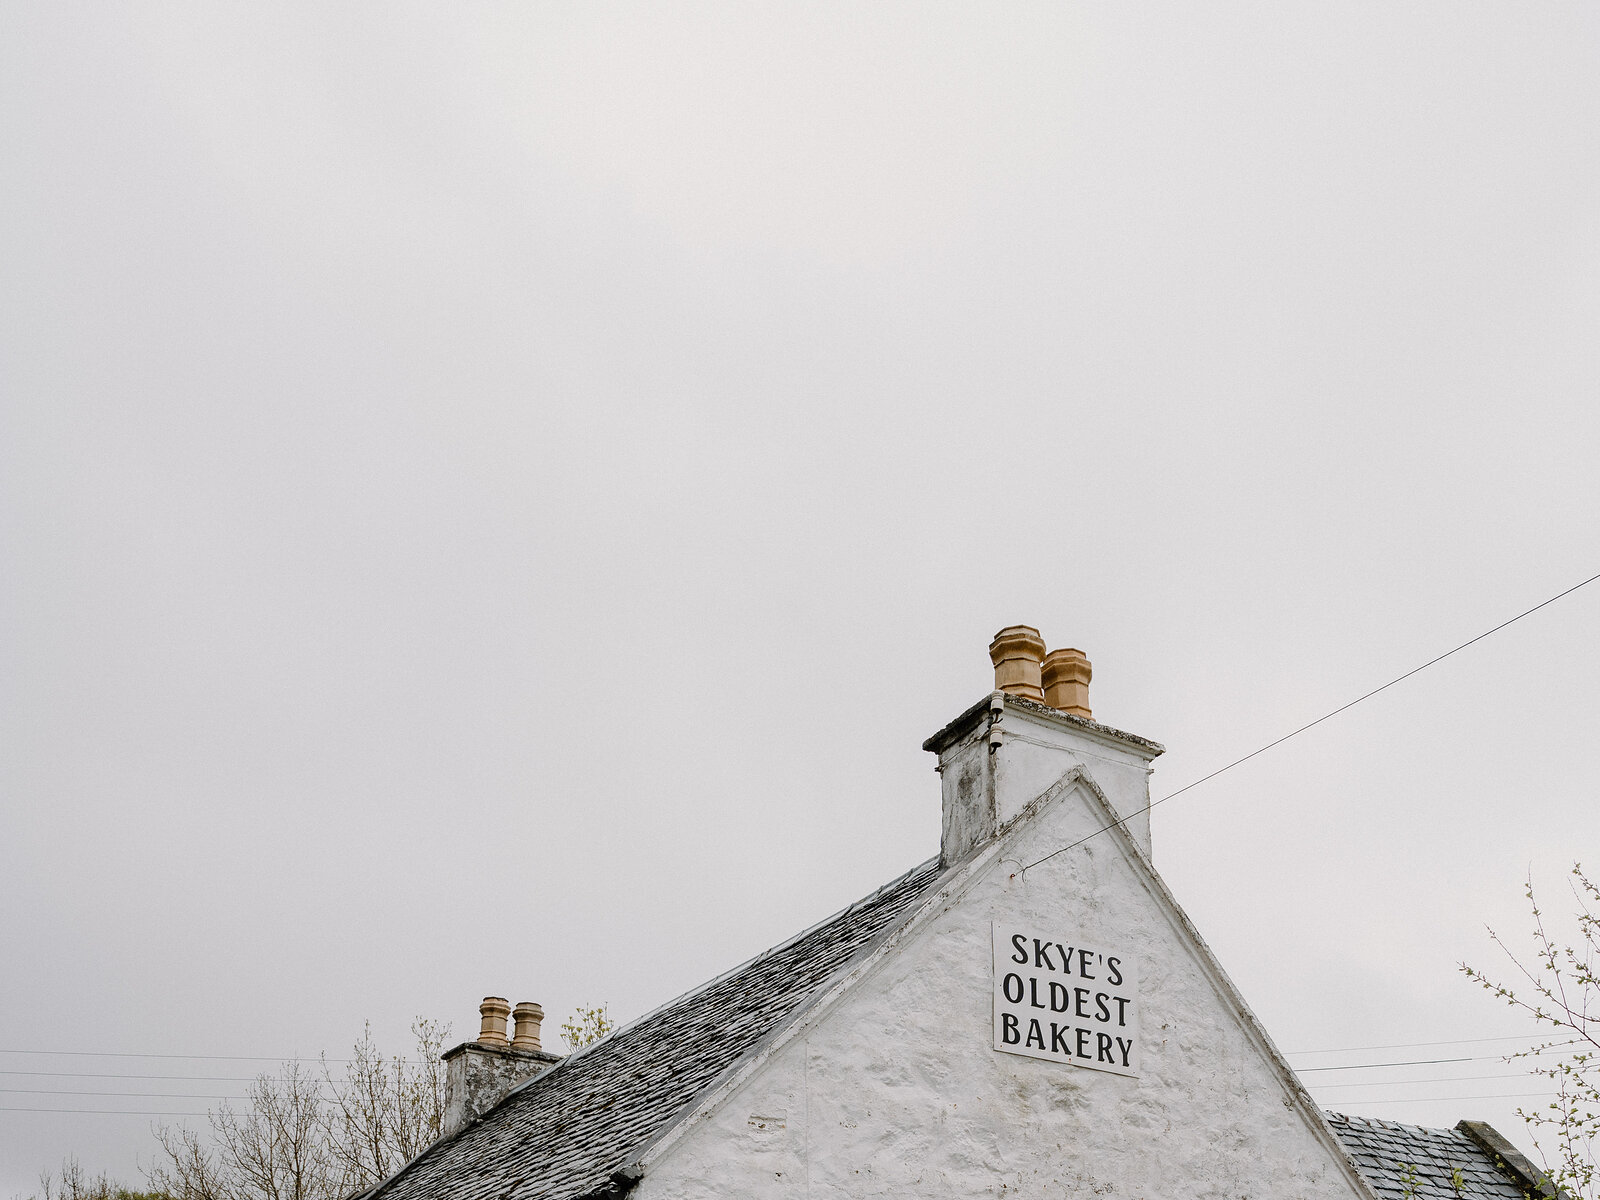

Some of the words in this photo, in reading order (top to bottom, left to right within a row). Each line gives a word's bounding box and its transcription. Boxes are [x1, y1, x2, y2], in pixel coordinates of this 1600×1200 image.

[1011, 934, 1123, 986] SKYE'S
[1003, 972, 1131, 1027] OLDEST
[1001, 1013, 1133, 1067] BAKERY
